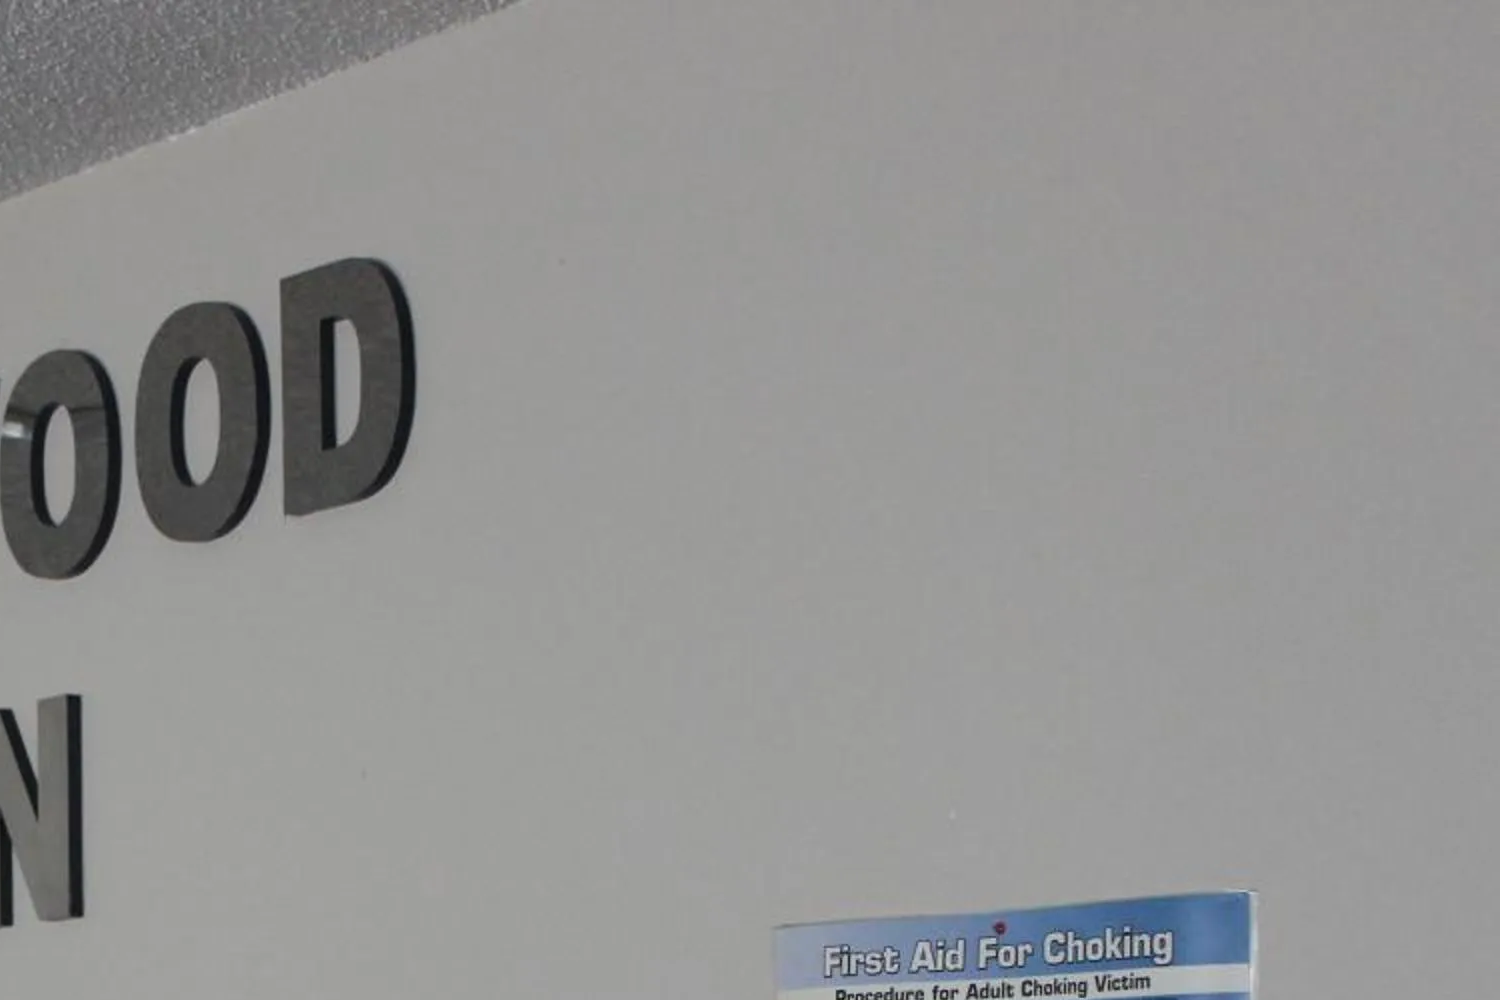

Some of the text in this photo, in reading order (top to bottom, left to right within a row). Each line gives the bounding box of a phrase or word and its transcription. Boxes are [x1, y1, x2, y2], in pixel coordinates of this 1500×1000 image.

[823, 926, 1174, 978] First Aid For Choking
[932, 982, 959, 1000] for
[966, 977, 1015, 1000] Adult
[1021, 977, 1088, 998] Choking
[1094, 972, 1151, 993] Victim
